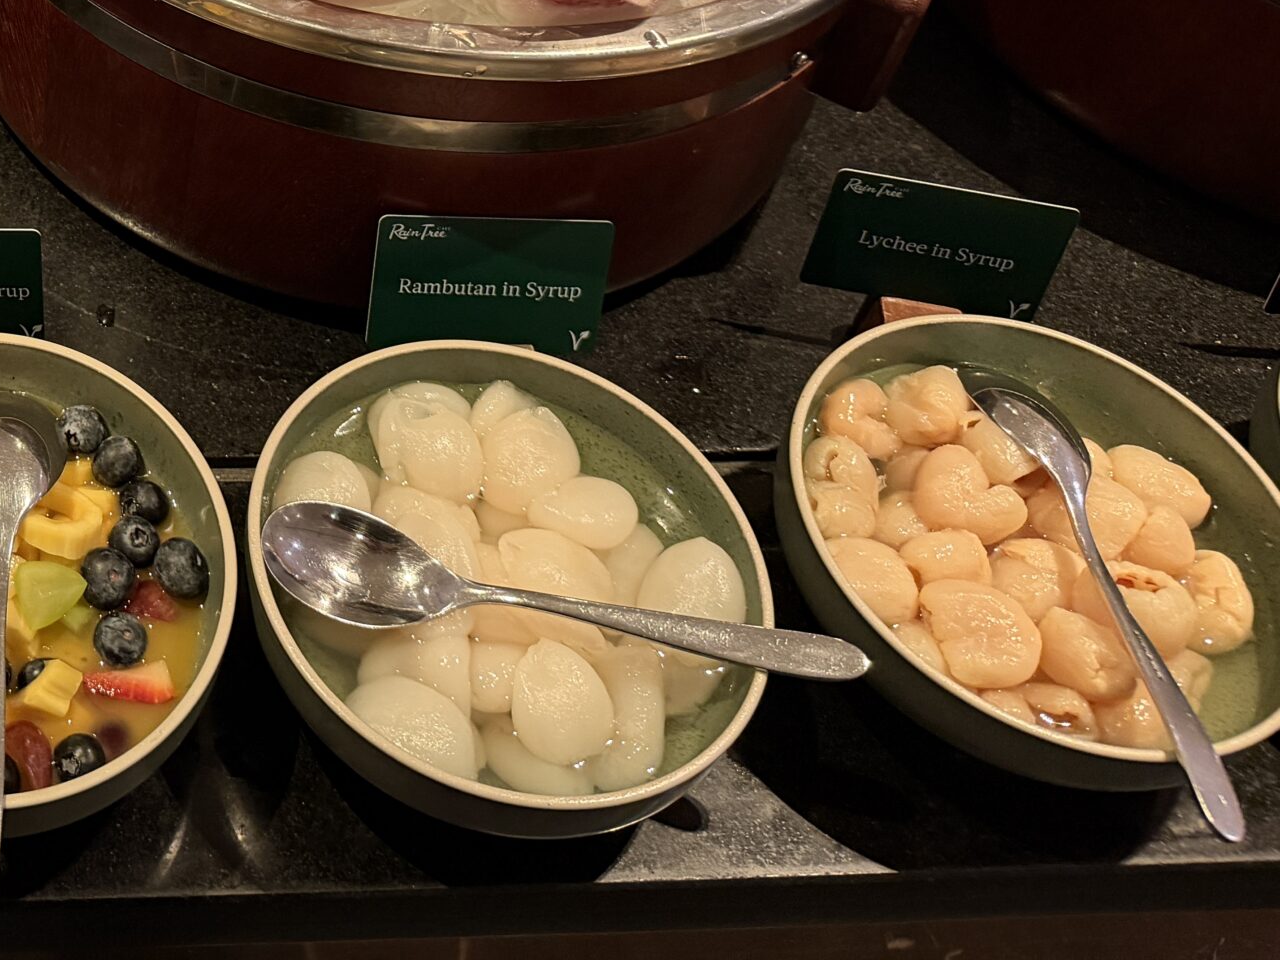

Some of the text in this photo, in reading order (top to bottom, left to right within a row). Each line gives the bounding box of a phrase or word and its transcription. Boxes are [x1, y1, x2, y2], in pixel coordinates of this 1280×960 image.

[858, 230, 1015, 273] Lychee in Syrup
[398, 278, 582, 302] Rambutan in Syrup
